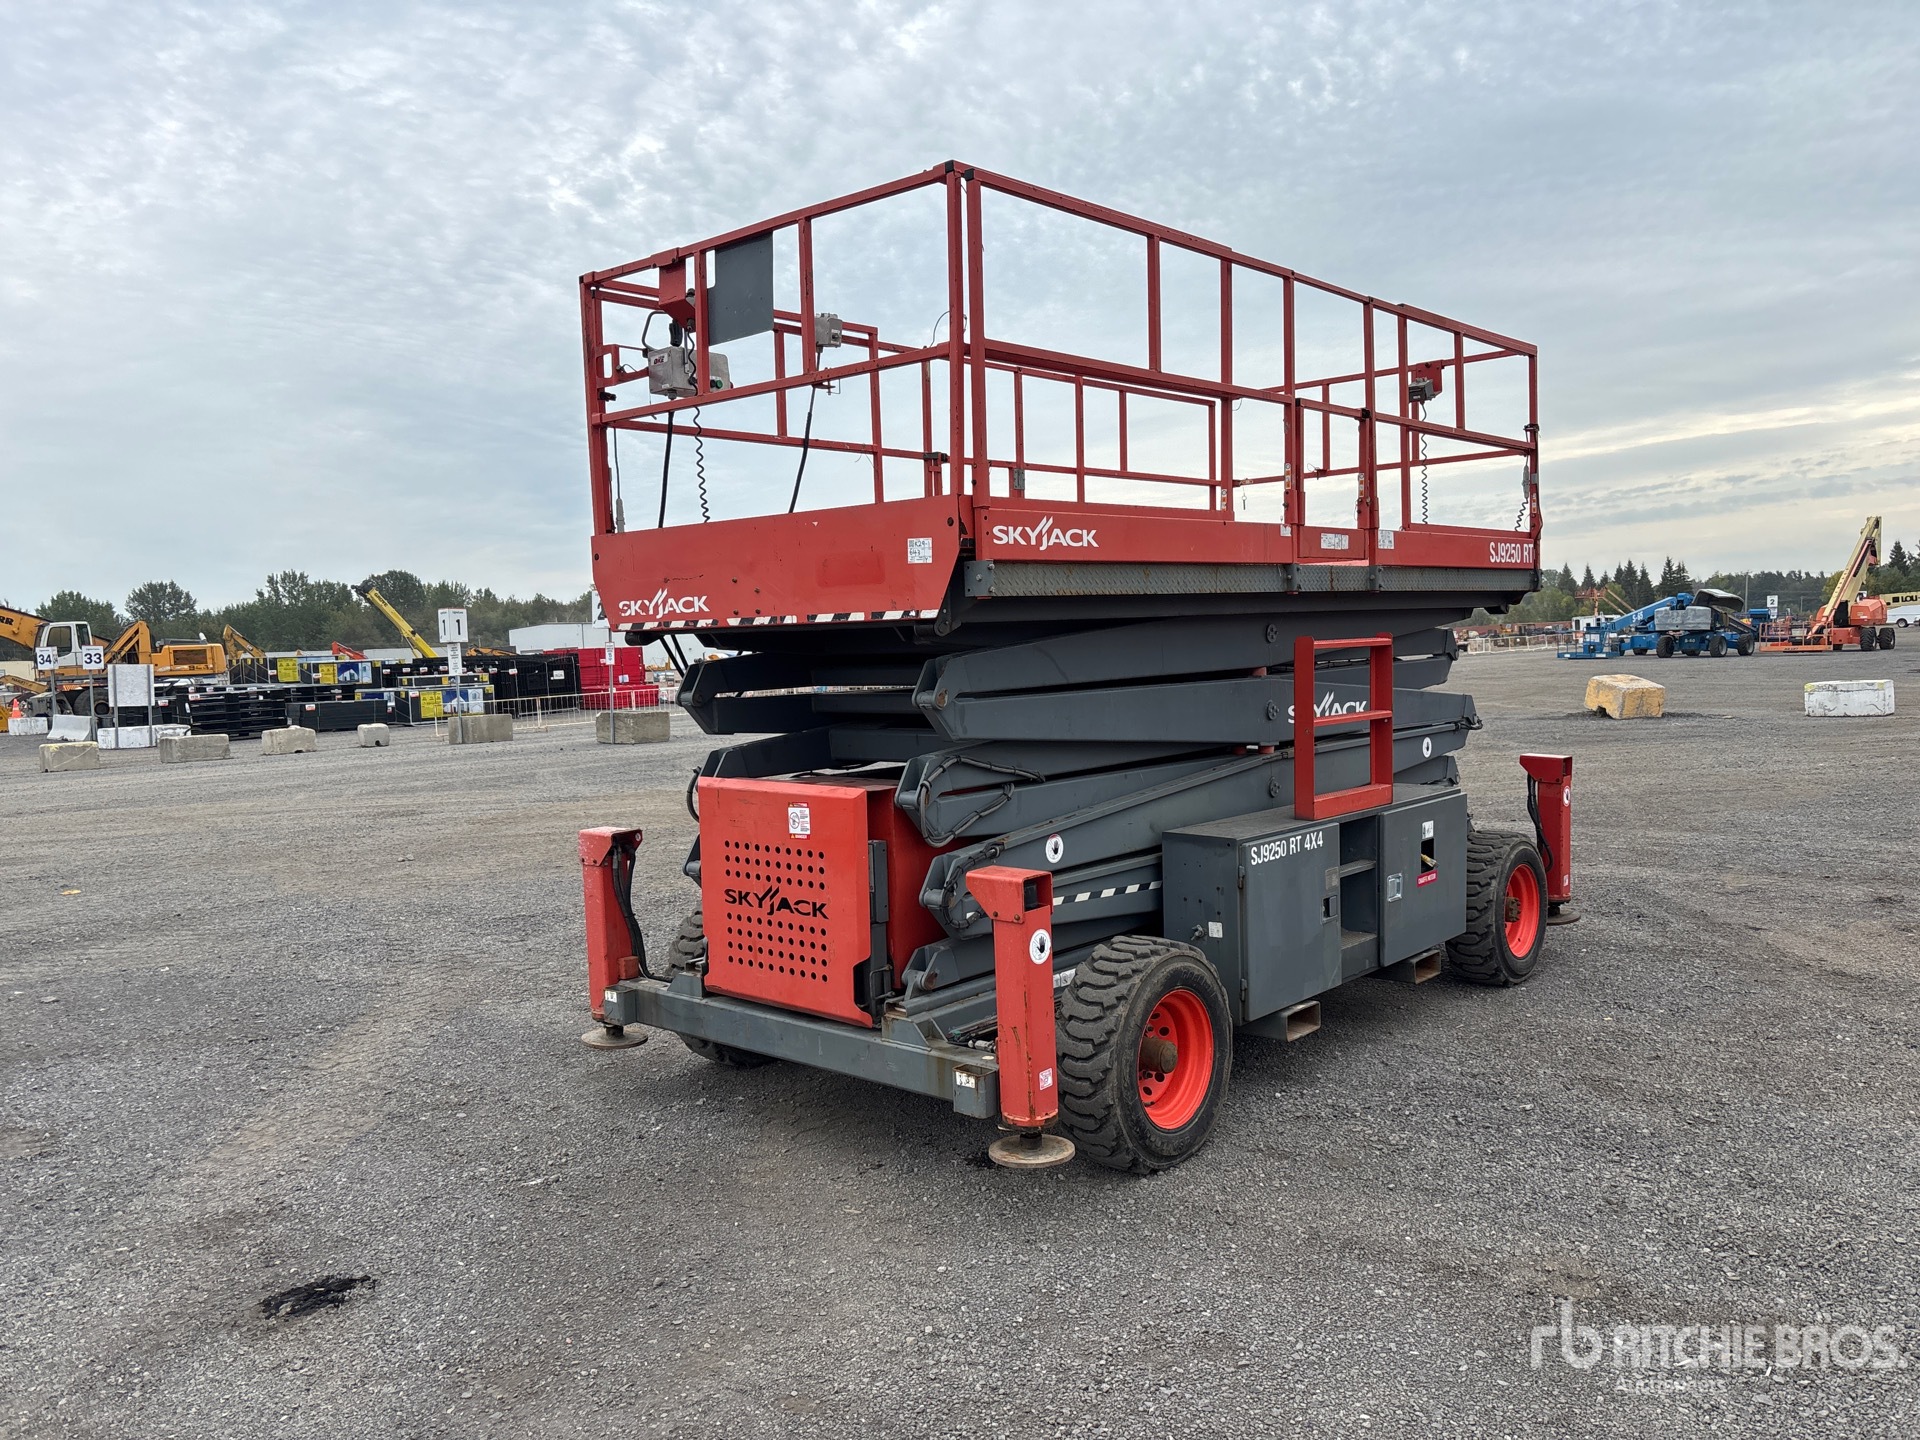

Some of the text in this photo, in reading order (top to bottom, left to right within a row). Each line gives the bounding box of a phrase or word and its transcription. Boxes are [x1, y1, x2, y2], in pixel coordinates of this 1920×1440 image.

[992, 515, 1099, 551] SKYJACK
[1490, 541, 1534, 563] SJ9250 RT
[618, 588, 710, 619] SKYJACK
[442, 619, 446, 636] 1
[455, 618, 461, 636] 1
[38, 654, 52, 665] 34
[84, 653, 102, 665] 33
[1251, 830, 1323, 866] SJ9250 RT 4X4
[724, 885, 829, 920] SKYJACK
